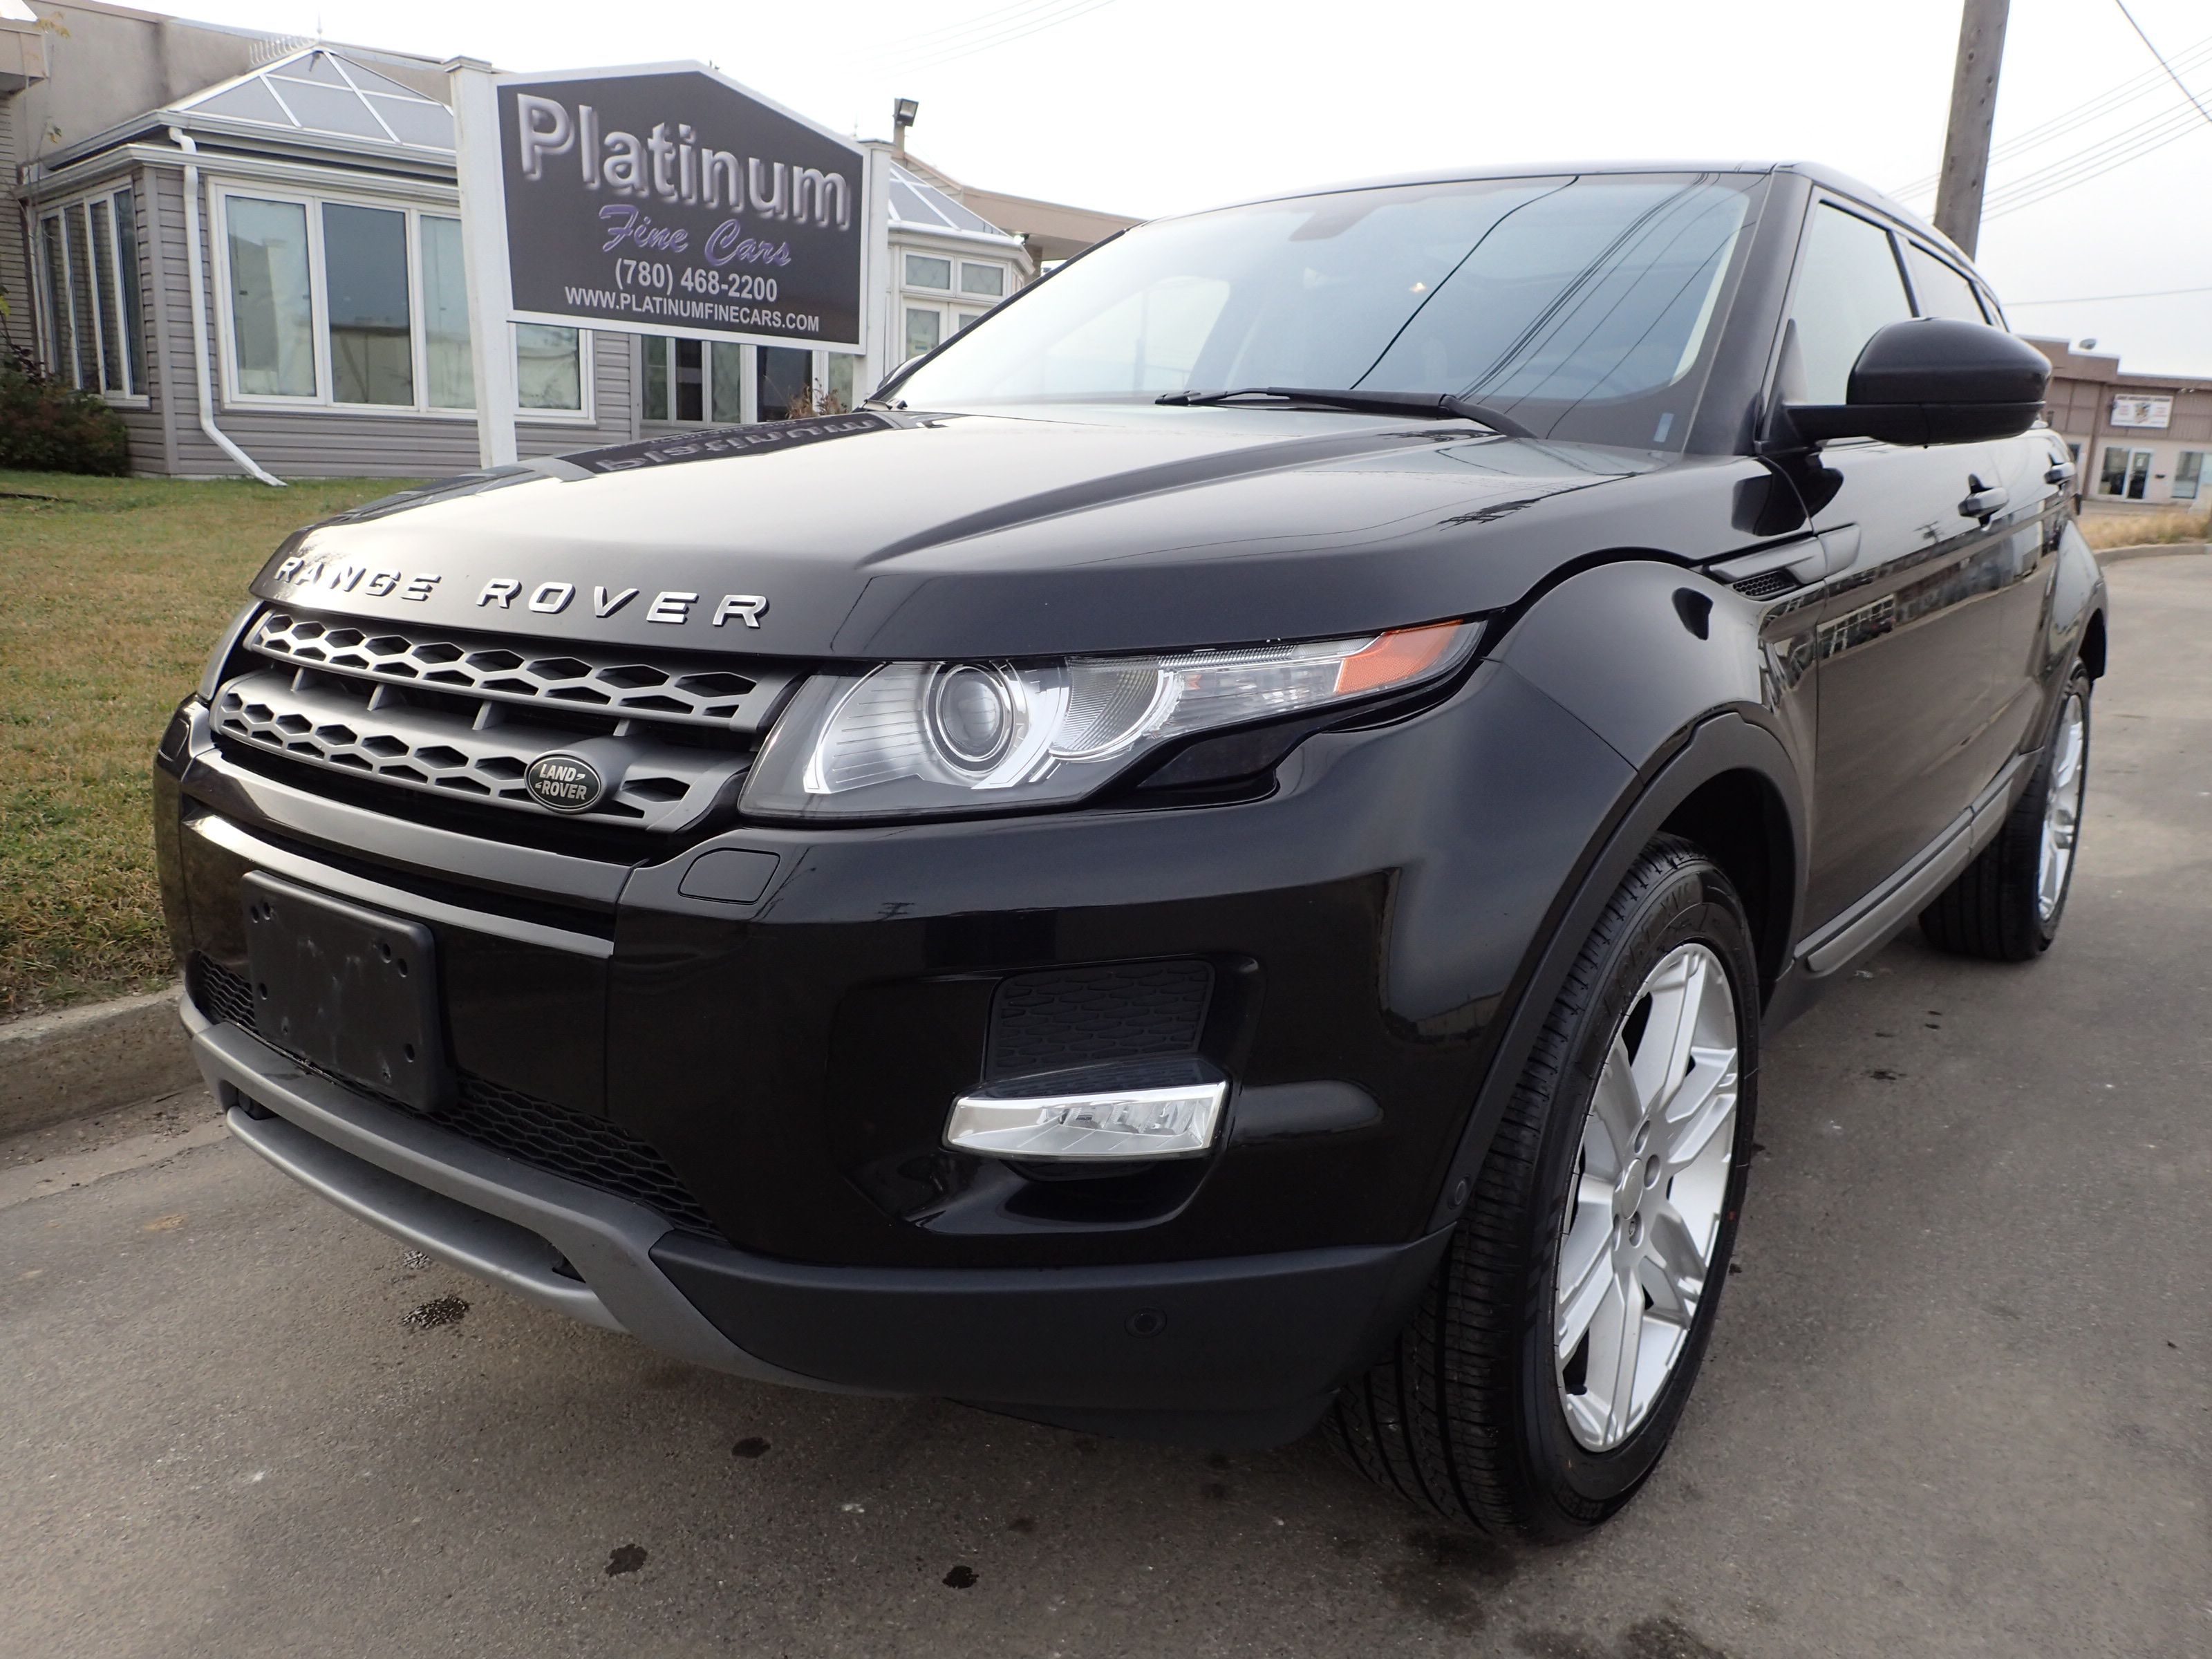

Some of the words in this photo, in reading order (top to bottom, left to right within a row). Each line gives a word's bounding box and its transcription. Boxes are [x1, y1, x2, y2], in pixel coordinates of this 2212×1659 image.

[516, 93, 850, 230] Platinum
[599, 205, 689, 252] Fine
[704, 218, 791, 267] Cars
[615, 258, 673, 295] (780)
[680, 267, 778, 302] 468-2200
[565, 286, 819, 332] WWW.PLATINUMFINECARS.COM
[274, 555, 442, 601] RANGE
[476, 577, 771, 629] ROVER
[539, 764, 577, 782] LAND
[541, 780, 587, 800] ROVER
